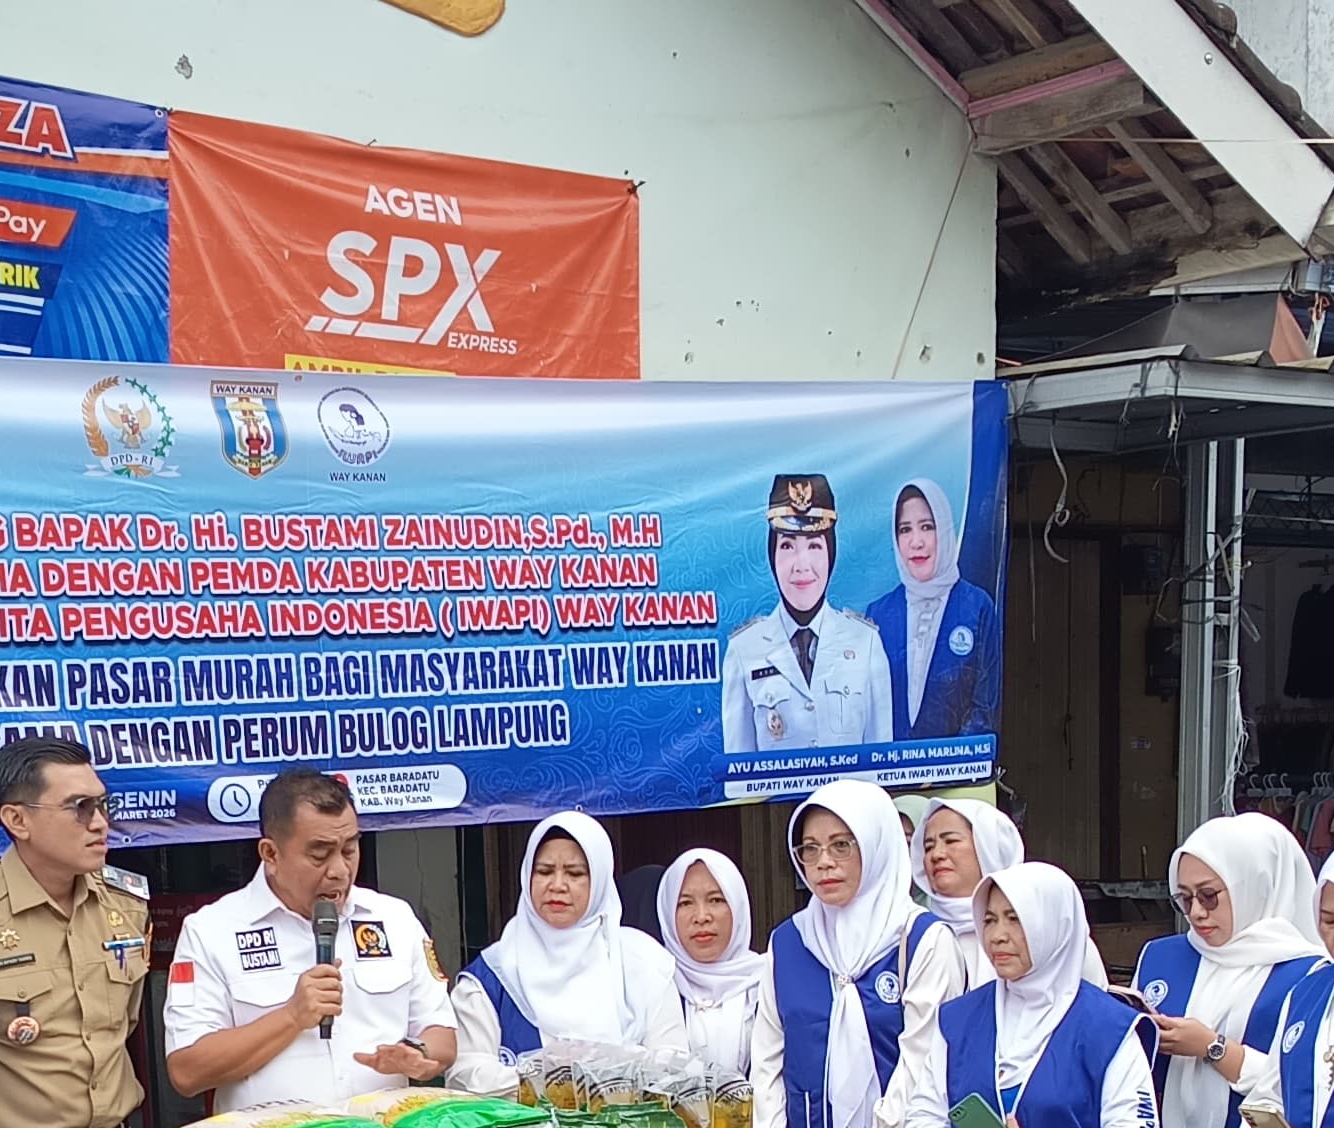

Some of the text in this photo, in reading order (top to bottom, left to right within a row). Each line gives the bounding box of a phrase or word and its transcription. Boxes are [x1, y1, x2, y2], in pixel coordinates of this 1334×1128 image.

[364, 184, 463, 225] AGEN
[319, 230, 502, 345] SPX
[447, 331, 518, 355] EXPRESS
[215, 385, 273, 396] WAY KANAN
[329, 472, 386, 482] WAY KANAN
[15, 516, 132, 548] BAPAK
[139, 517, 187, 549] Dr.
[194, 513, 236, 548] Hi.
[243, 517, 378, 548] BUSTAMI
[611, 517, 660, 547] M.H
[42, 561, 181, 593] DENGAN
[191, 561, 300, 592] PEMDA
[307, 558, 484, 590] KABUPATEN
[490, 557, 554, 587] WAY
[562, 555, 657, 586] KANAN
[61, 604, 264, 639] PENGUSAHA
[269, 601, 434, 635] INDONESIA
[556, 597, 619, 626] WAY
[624, 594, 715, 625] KANAN
[67, 660, 174, 706] PASAR
[182, 657, 295, 702] MURAH
[304, 654, 371, 698] BAGI
[380, 647, 564, 694] MASYARAKAT
[570, 645, 627, 686] WAY
[636, 642, 717, 682] KANAN
[88, 718, 214, 768] DENGAN
[223, 714, 325, 761] PERUM
[334, 711, 429, 750] BULOG
[437, 703, 567, 748] LAMPUNG
[356, 770, 440, 784] PASAR BARADATU
[728, 763, 750, 774] AYU
[877, 764, 987, 781] KETUA IWAPI WAY KANAN
[357, 783, 430, 796] KEC. BARADATU
[747, 781, 780, 792] BUPATI
[783, 779, 803, 790] WAY
[113, 790, 176, 809] SENIN
[114, 809, 176, 821] MARET 2026
[237, 930, 274, 949] DPD RI
[241, 950, 280, 969] BUSTAMI
